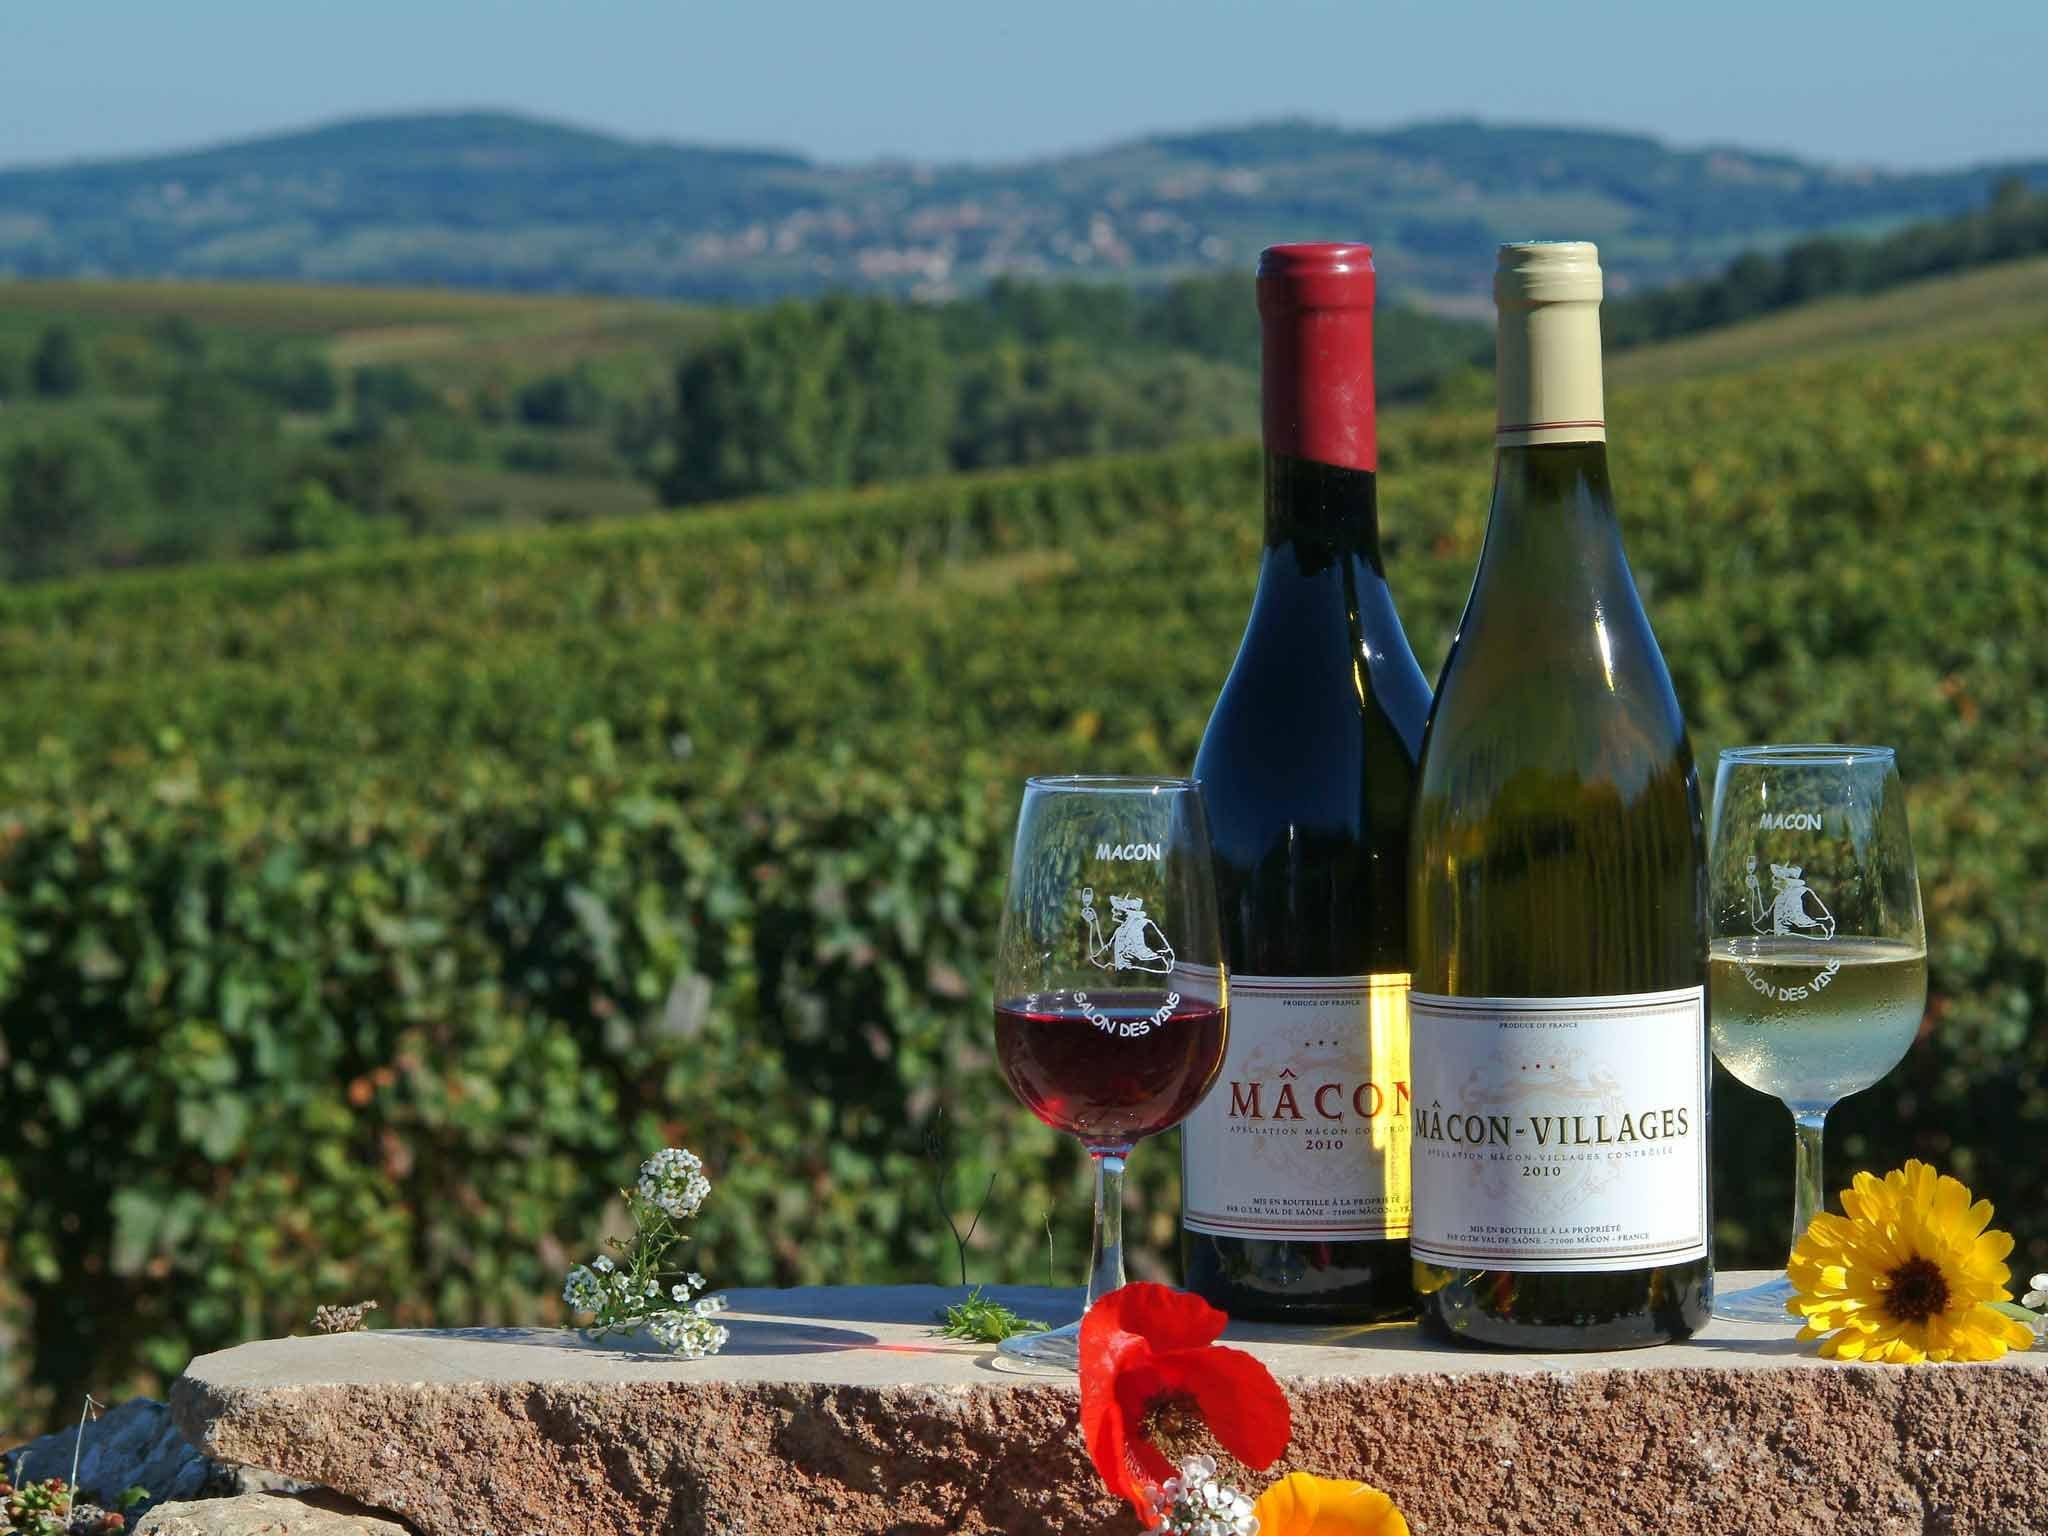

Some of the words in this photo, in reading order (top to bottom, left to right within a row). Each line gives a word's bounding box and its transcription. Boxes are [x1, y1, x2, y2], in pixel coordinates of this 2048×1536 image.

[1760, 814, 1823, 830] MACON
[1095, 843, 1161, 861] MACON
[1779, 986, 1808, 1002] DES
[1808, 958, 1841, 993] VINS
[1320, 999, 1329, 1007] OF
[1073, 991, 1116, 1034] SALON
[1119, 1023, 1150, 1038] DES
[1150, 991, 1181, 1027] VINS
[1415, 1100, 1690, 1146] MÂCON-VILLAGES
[1305, 1139, 1344, 1151] 2010
[1522, 1166, 1561, 1177] 2010
[1269, 1198, 1281, 1206] EN
[1340, 1198, 1351, 1206] LA
[1264, 1207, 1280, 1215] VAL
[1281, 1207, 1292, 1215] DE
[1500, 1227, 1548, 1235] BOUTEILLE
[1559, 1226, 1569, 1234] LA
[1481, 1235, 1496, 1244] VAL
